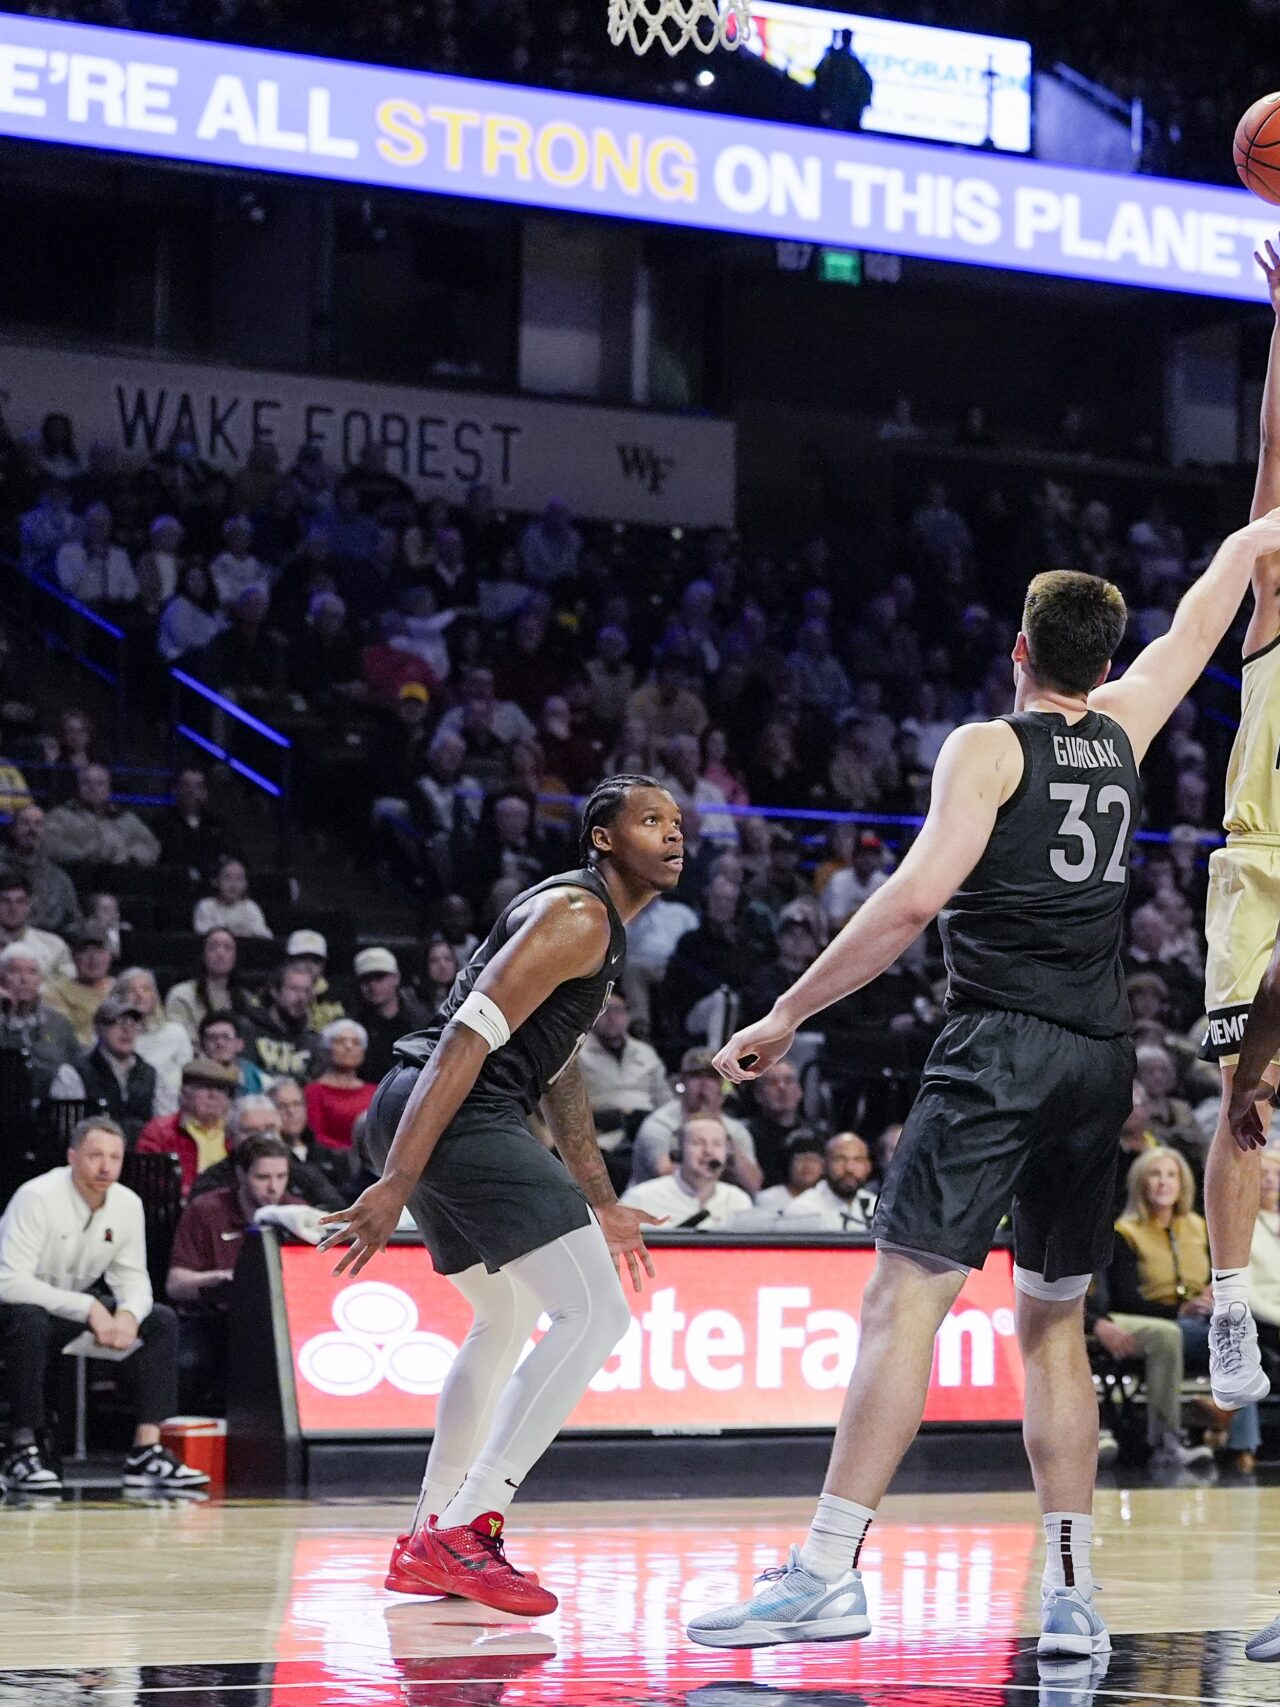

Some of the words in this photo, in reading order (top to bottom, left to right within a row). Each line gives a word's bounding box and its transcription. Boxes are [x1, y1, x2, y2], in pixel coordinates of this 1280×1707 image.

[196, 74, 359, 160] ALL
[377, 99, 698, 203] STRONG
[713, 145, 821, 221] ON
[834, 160, 1002, 246] THIS
[115, 385, 282, 462] WAKE
[1049, 783, 1131, 883] 32
